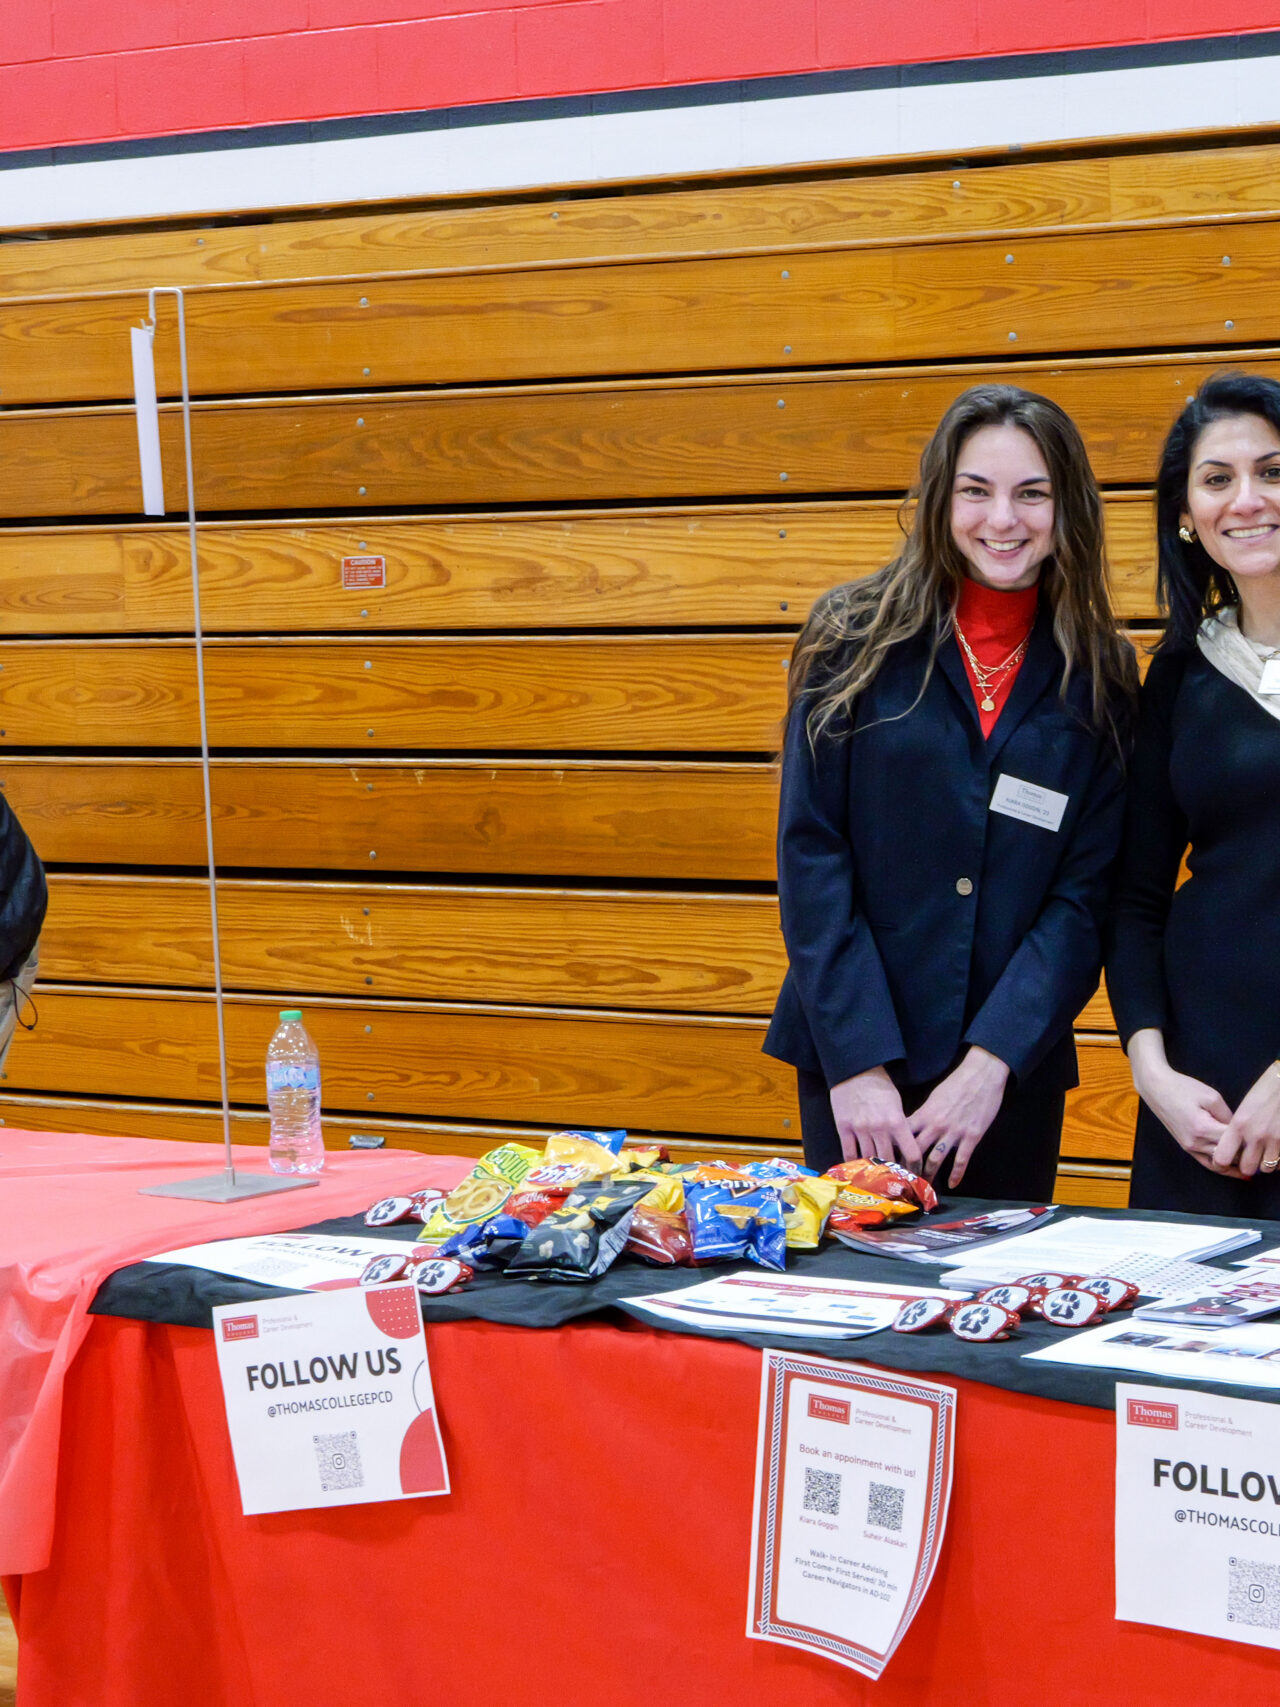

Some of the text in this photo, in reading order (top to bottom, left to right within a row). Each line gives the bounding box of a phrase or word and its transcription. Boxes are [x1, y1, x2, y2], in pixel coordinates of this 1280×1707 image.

[246, 1347, 402, 1392] FOLLOW US
[267, 1391, 393, 1418] @THOMASCOLLEGEPCD
[813, 1399, 846, 1414] Thomas
[1133, 1404, 1172, 1419] Thomas
[1184, 1411, 1226, 1424] Professional
[1184, 1421, 1253, 1437] Career Development
[799, 1443, 820, 1456] Book
[822, 1450, 832, 1458] an
[884, 1463, 902, 1475] with
[904, 1469, 916, 1478] us!
[795, 1557, 811, 1567] First
[836, 1567, 850, 1577] First
[887, 1583, 898, 1591] min
[838, 1556, 860, 1567] Career
[861, 1563, 888, 1578] Advising
[802, 1570, 825, 1581] Career
[826, 1577, 861, 1592] Navigators
[862, 1586, 869, 1594] in
